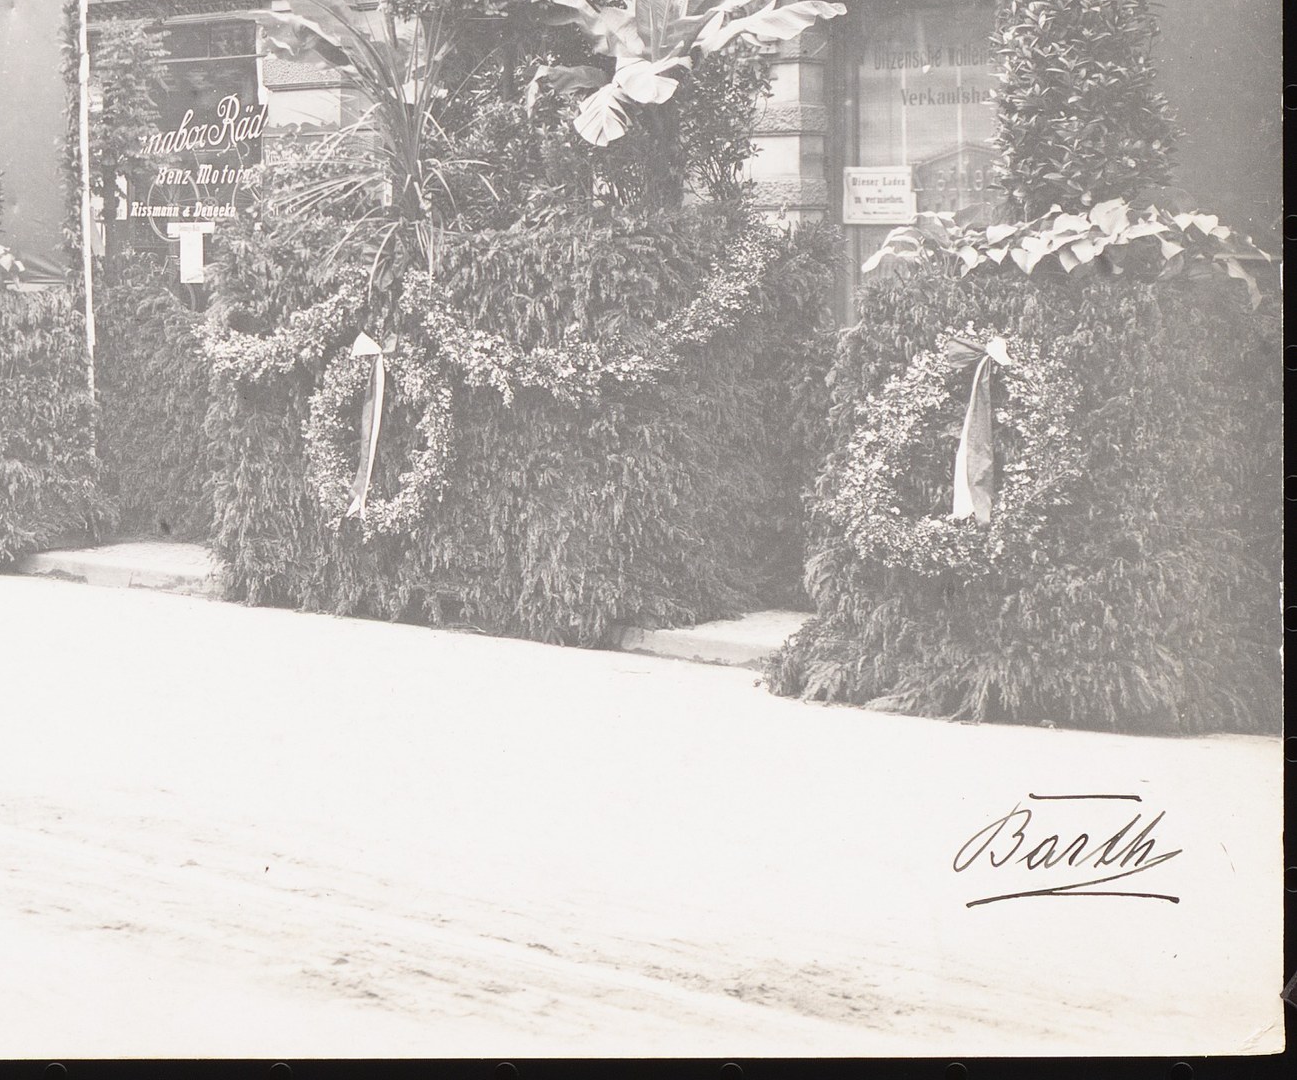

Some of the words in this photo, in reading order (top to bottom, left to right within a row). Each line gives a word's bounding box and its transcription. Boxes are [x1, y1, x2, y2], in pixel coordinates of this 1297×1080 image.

[208, 93, 269, 145] Räd
[156, 166, 192, 185] Benz
[130, 202, 180, 218] Rissmann
